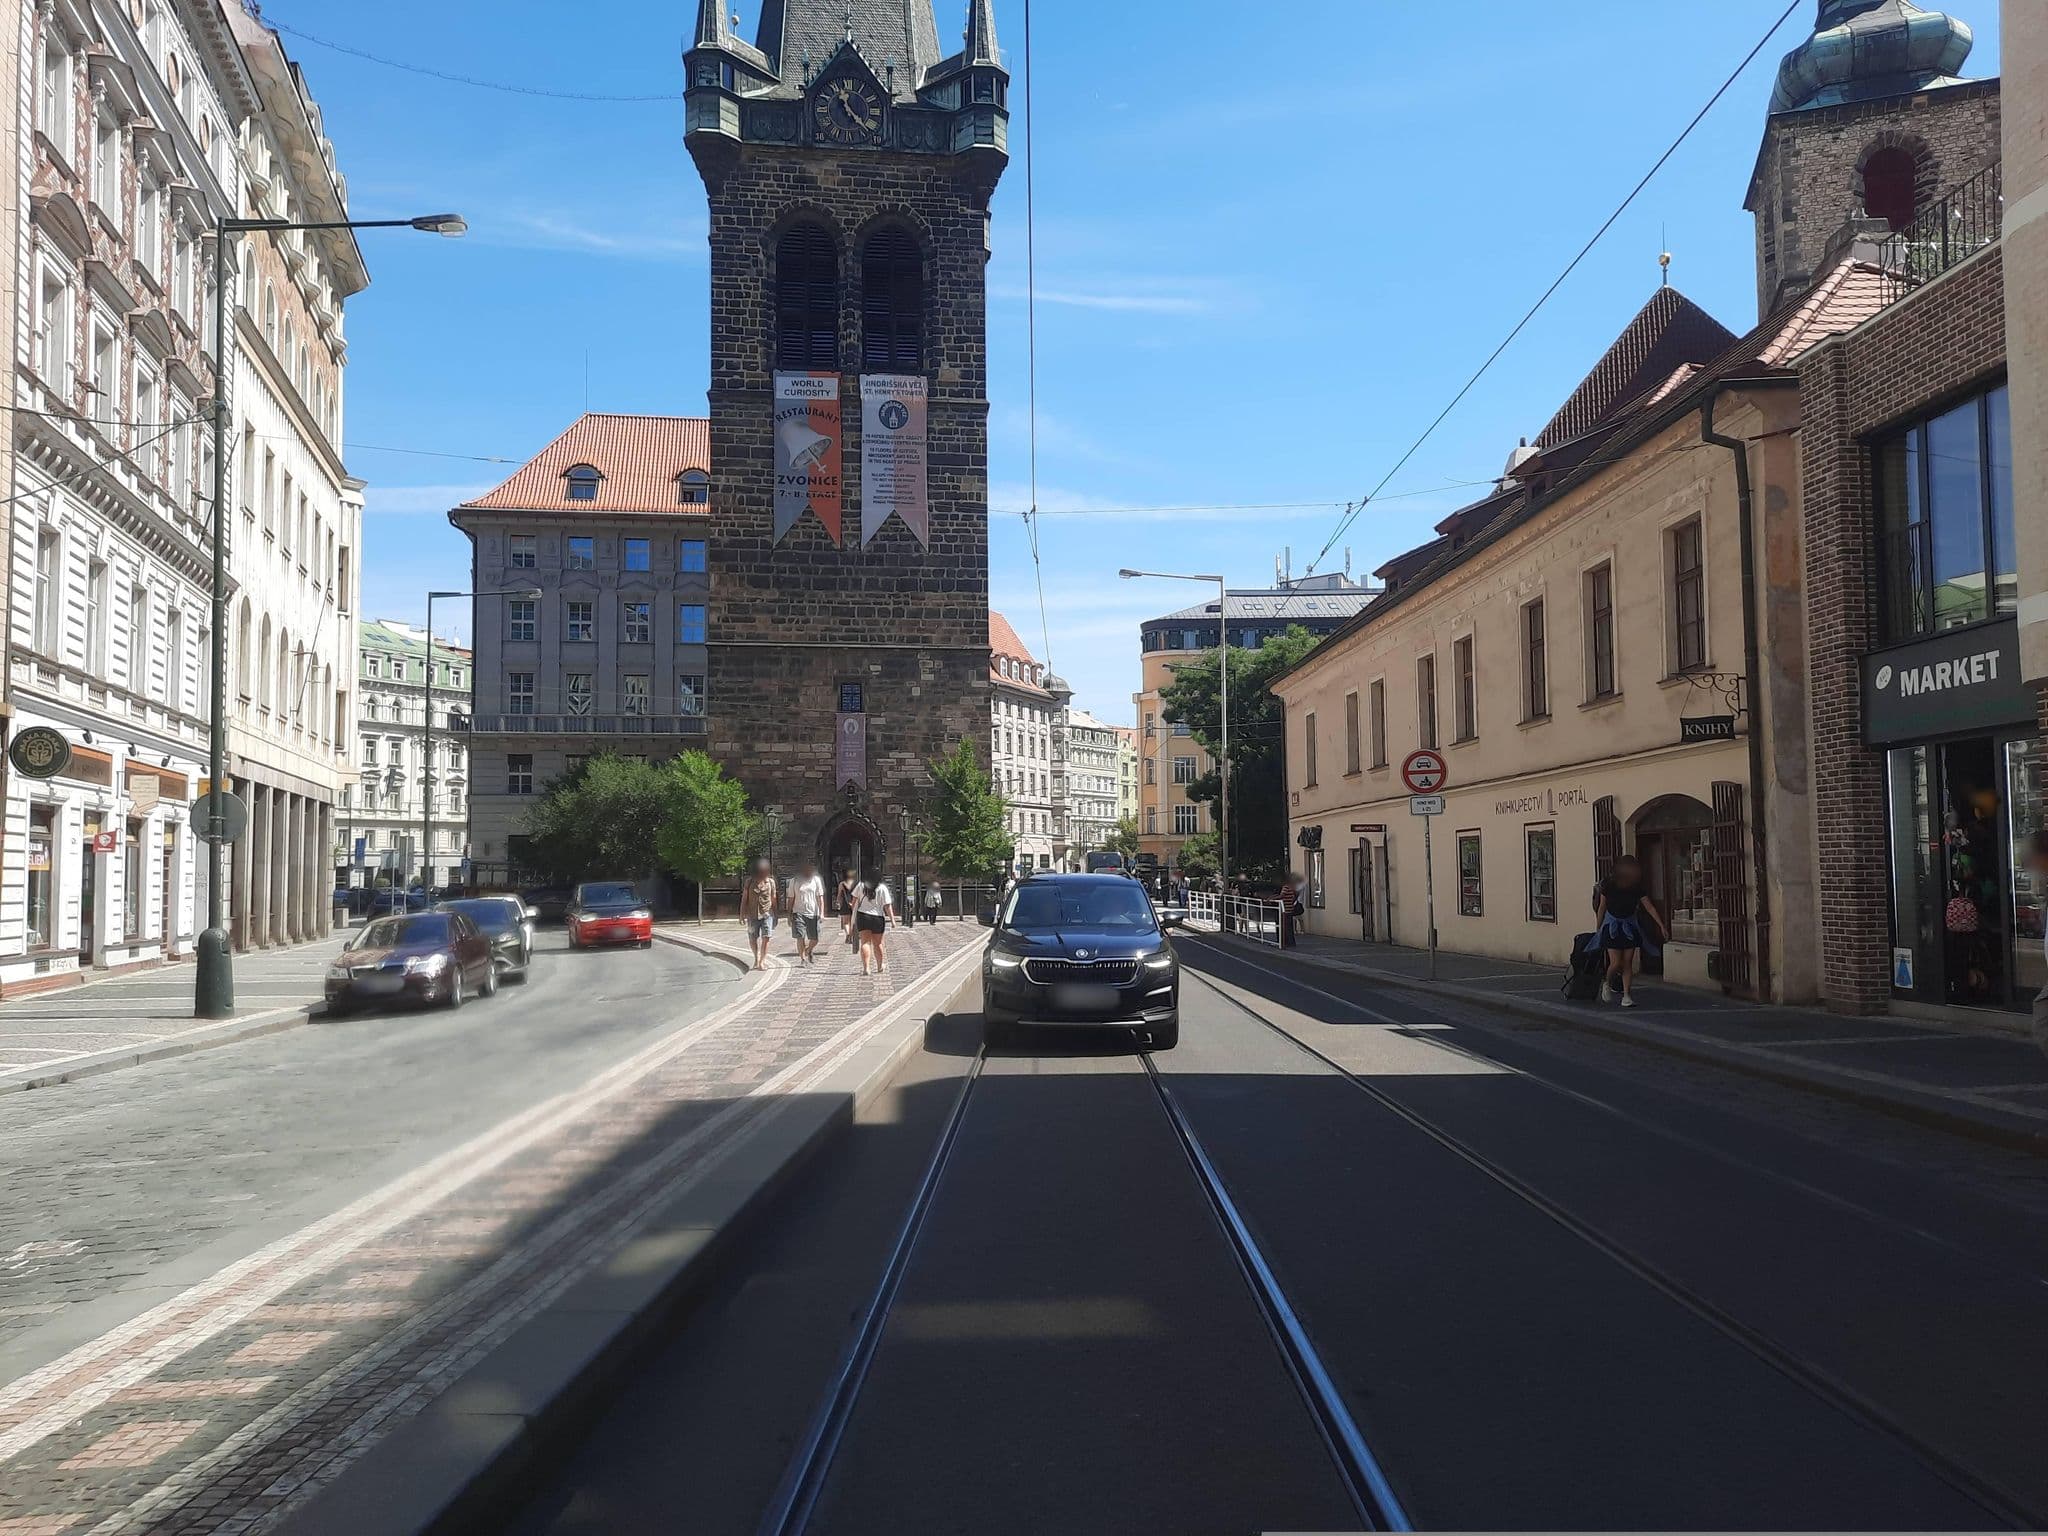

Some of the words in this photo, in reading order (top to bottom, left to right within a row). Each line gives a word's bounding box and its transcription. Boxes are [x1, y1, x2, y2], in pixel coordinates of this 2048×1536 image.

[791, 380, 824, 388] WORLD
[784, 389, 831, 397] CURIOSITY
[775, 407, 840, 424] RESTAURANT
[777, 475, 838, 486] ZVONICE
[1900, 649, 2000, 698] MARKET
[1685, 723, 1730, 736] KNIHY
[1495, 792, 1543, 815] KNIHKUPECTVÍ
[1558, 784, 1588, 807] PORTÁL
